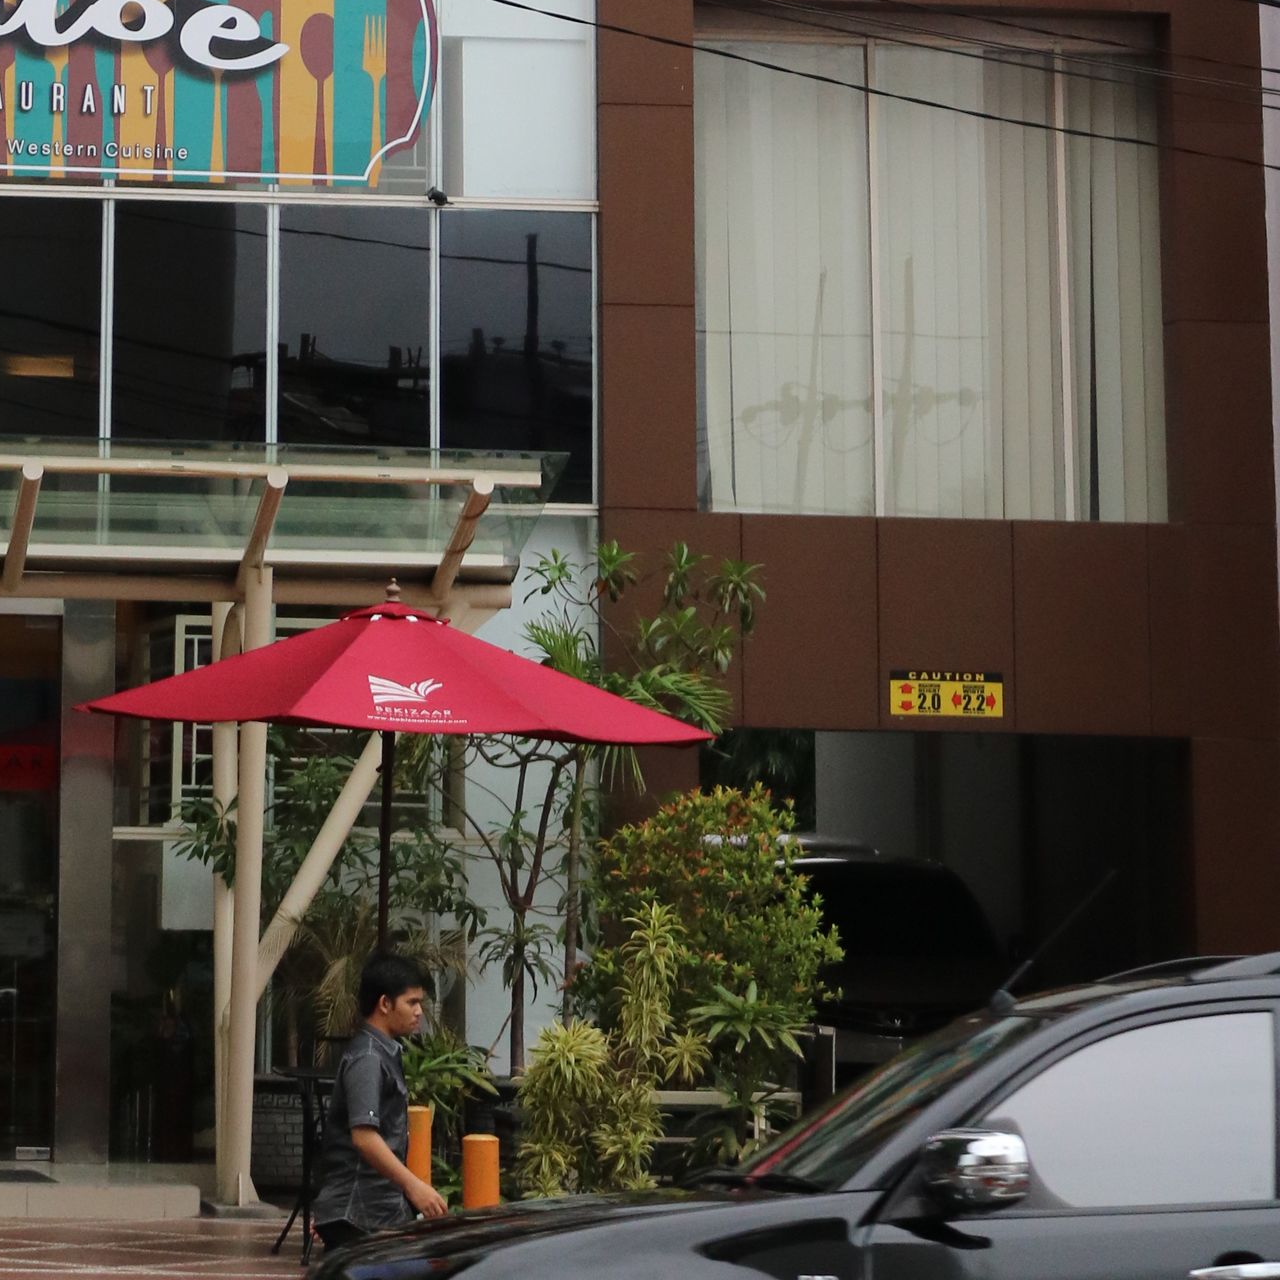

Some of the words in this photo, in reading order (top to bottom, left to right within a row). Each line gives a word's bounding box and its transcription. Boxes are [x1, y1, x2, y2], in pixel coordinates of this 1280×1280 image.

[7, 138, 98, 158] Western
[104, 141, 189, 161] Cuisine
[908, 671, 985, 681] CAUTION
[918, 693, 941, 711] 2.0
[962, 694, 986, 712] 2.2
